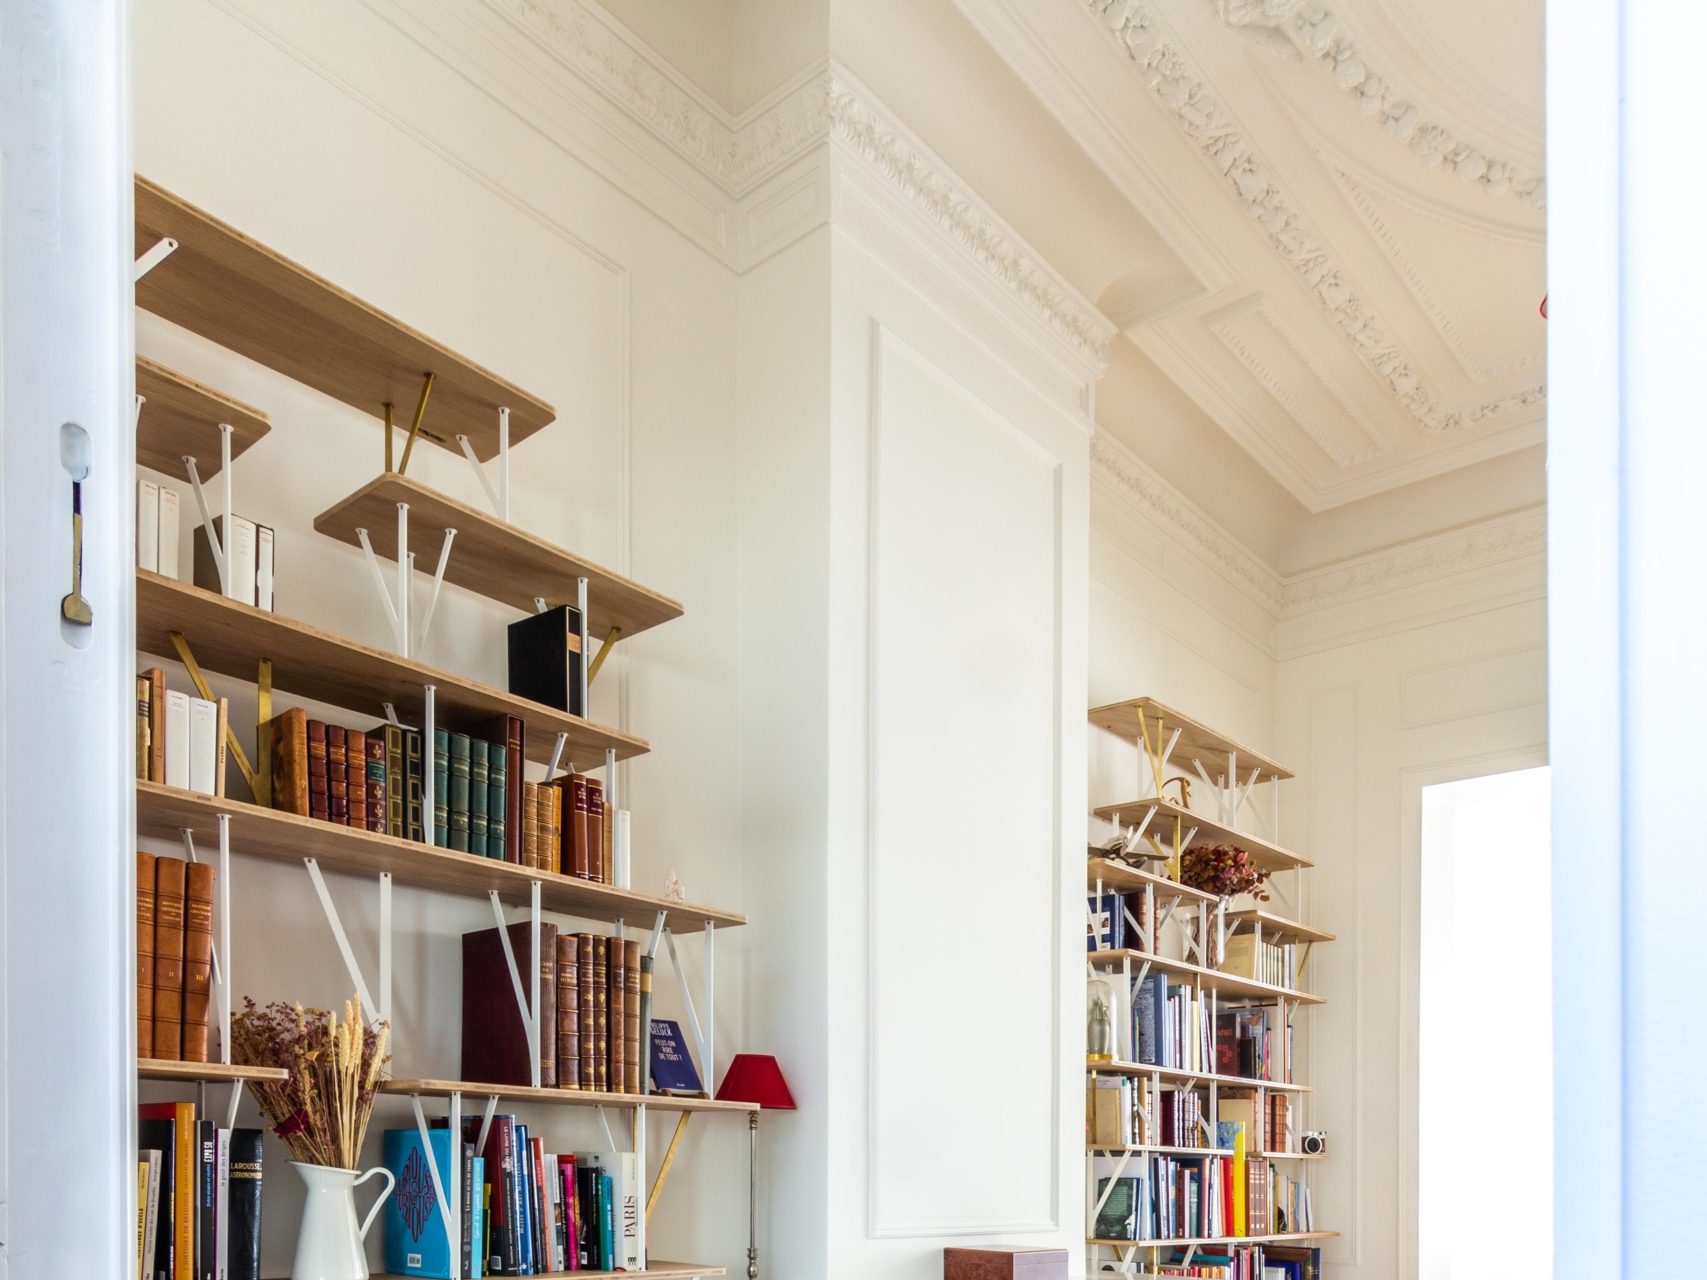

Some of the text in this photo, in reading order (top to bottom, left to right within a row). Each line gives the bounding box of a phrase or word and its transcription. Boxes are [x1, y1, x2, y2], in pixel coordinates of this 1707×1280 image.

[655, 1039, 676, 1047] PEUT-ON
[666, 1053, 679, 1061] TOUT
[204, 1149, 213, 1163] EXPO
[230, 1162, 261, 1170] LAROUSSE
[624, 1195, 635, 1238] PARIS
[183, 1226, 188, 1234] DE
